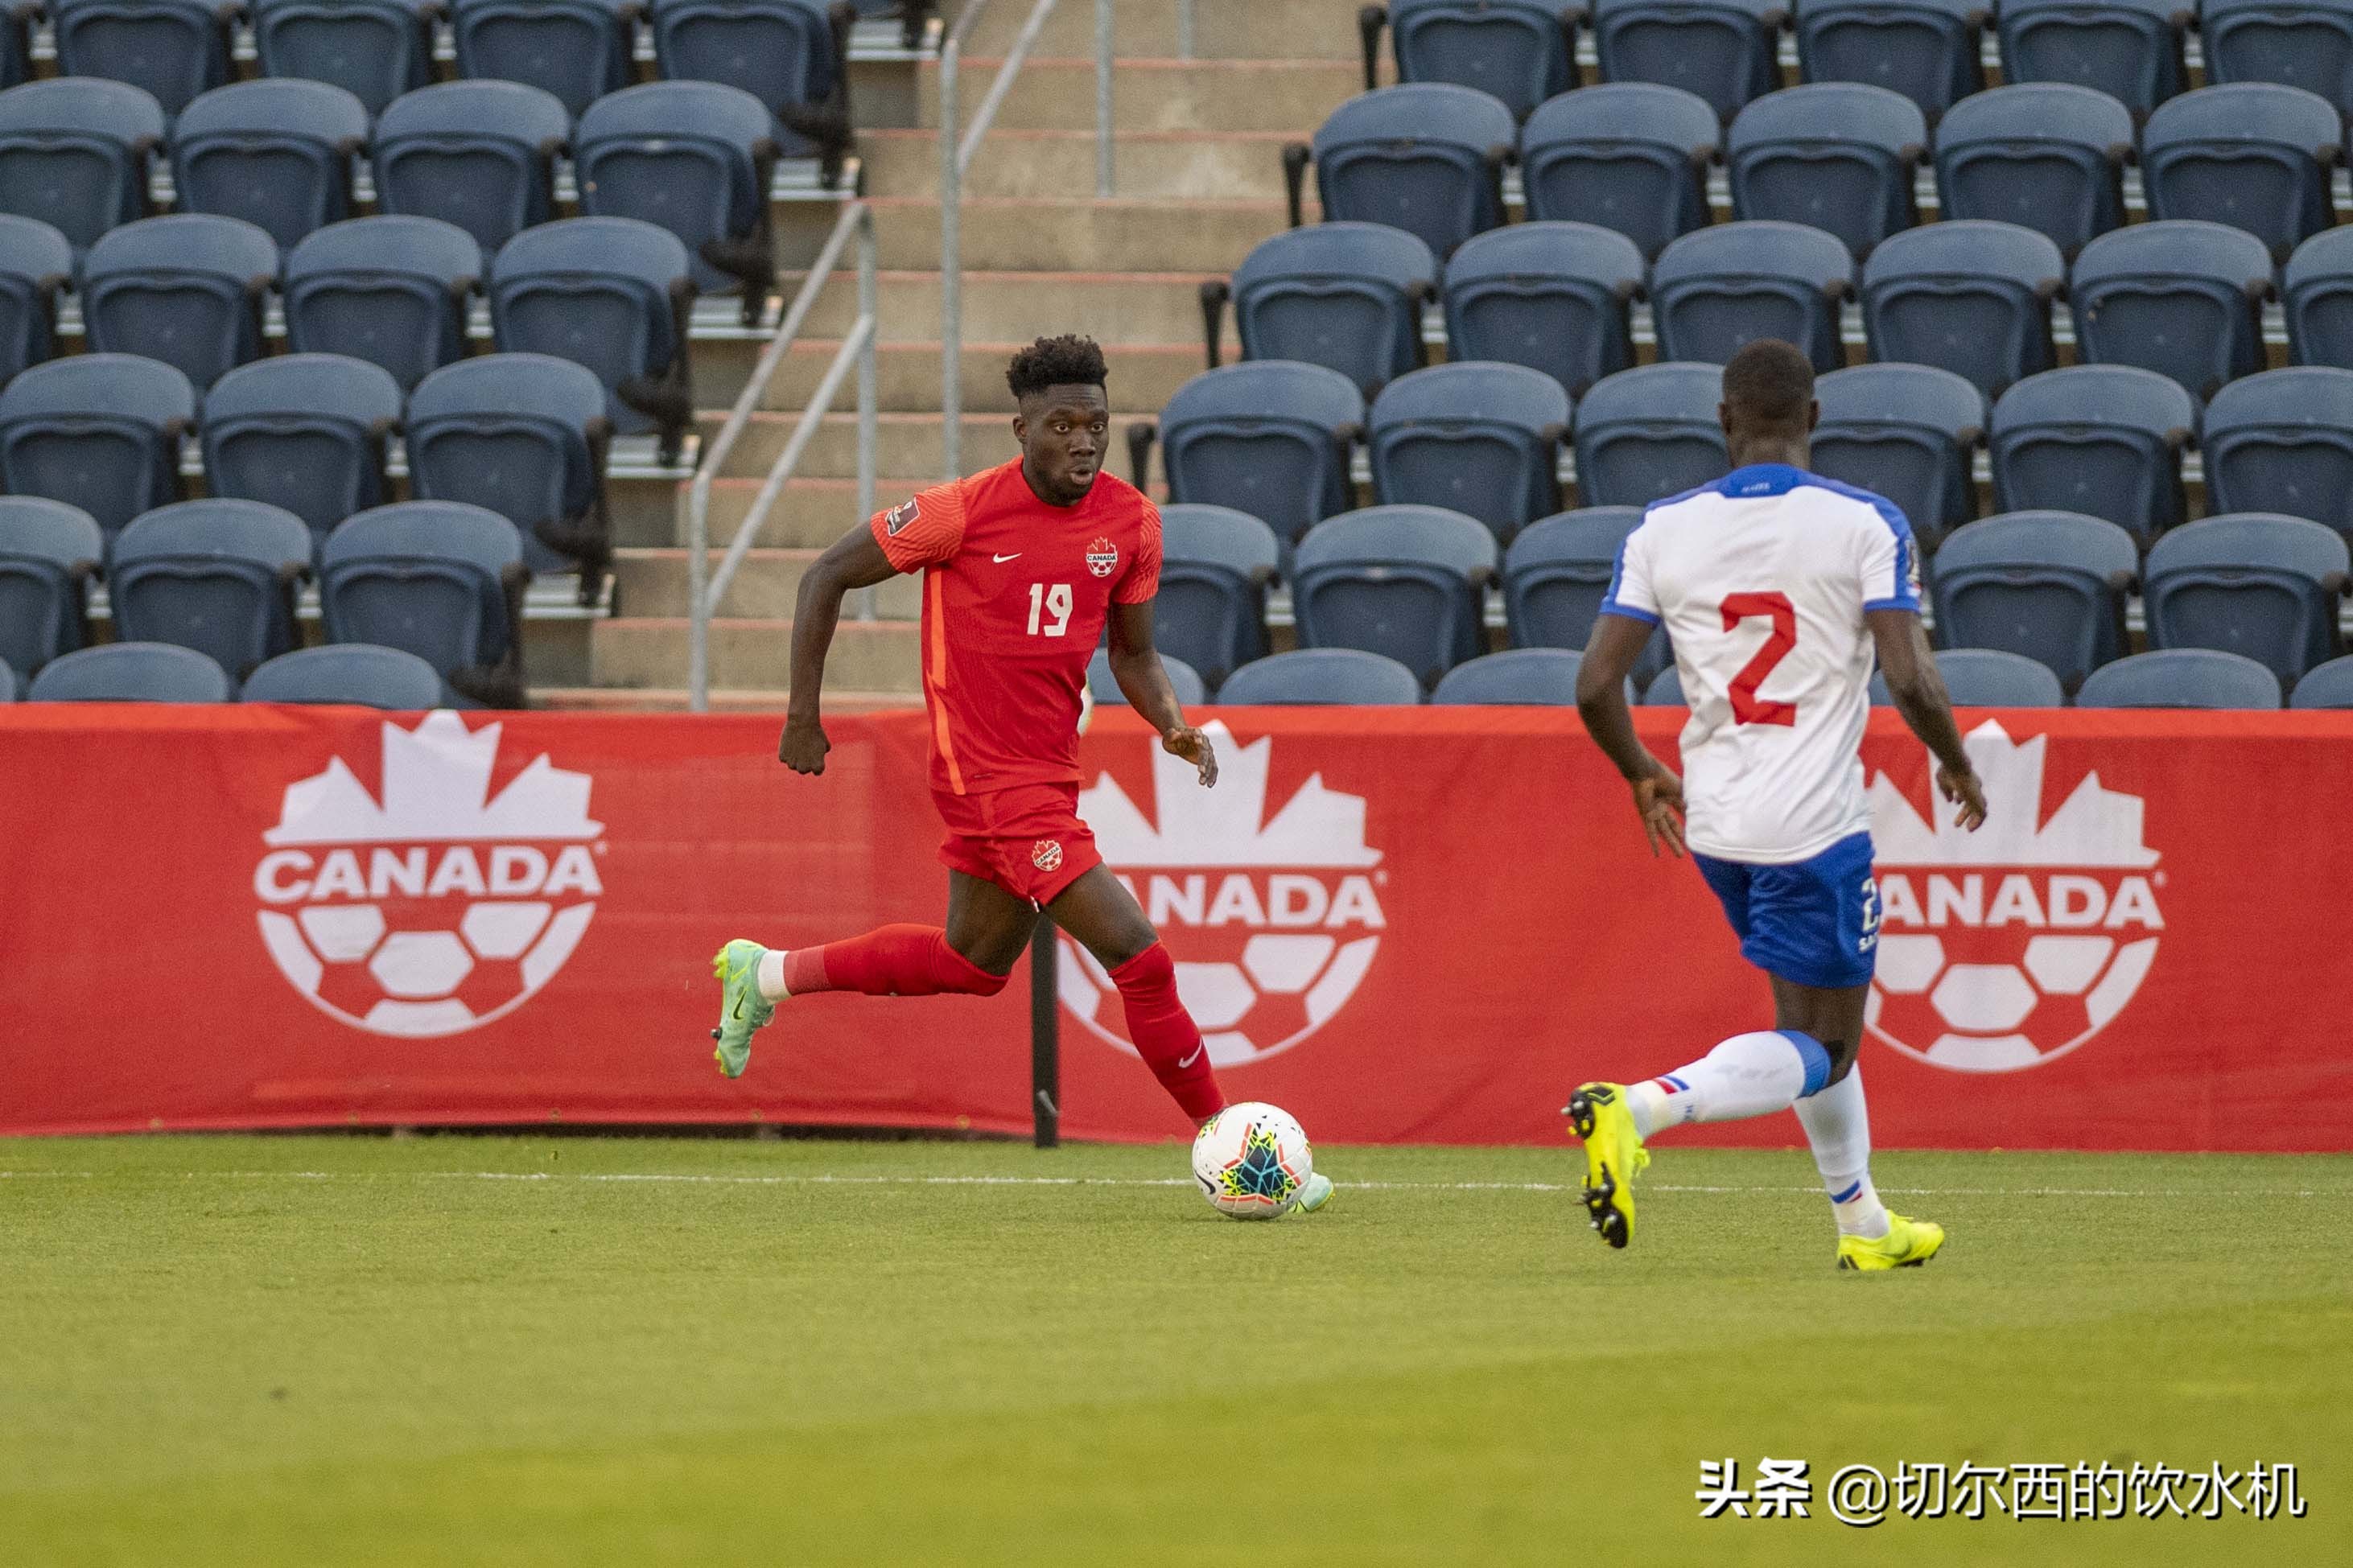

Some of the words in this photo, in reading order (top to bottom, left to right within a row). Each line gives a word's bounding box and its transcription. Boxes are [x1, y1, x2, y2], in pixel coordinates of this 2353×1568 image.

[1027, 582, 1073, 637] 19
[1718, 591, 1798, 727] 2
[254, 846, 604, 903] CANADA
[1036, 846, 1060, 866] CANADA
[1114, 873, 1387, 928] NADA
[1861, 877, 1880, 932] 2
[1879, 874, 2166, 930] ANADA
